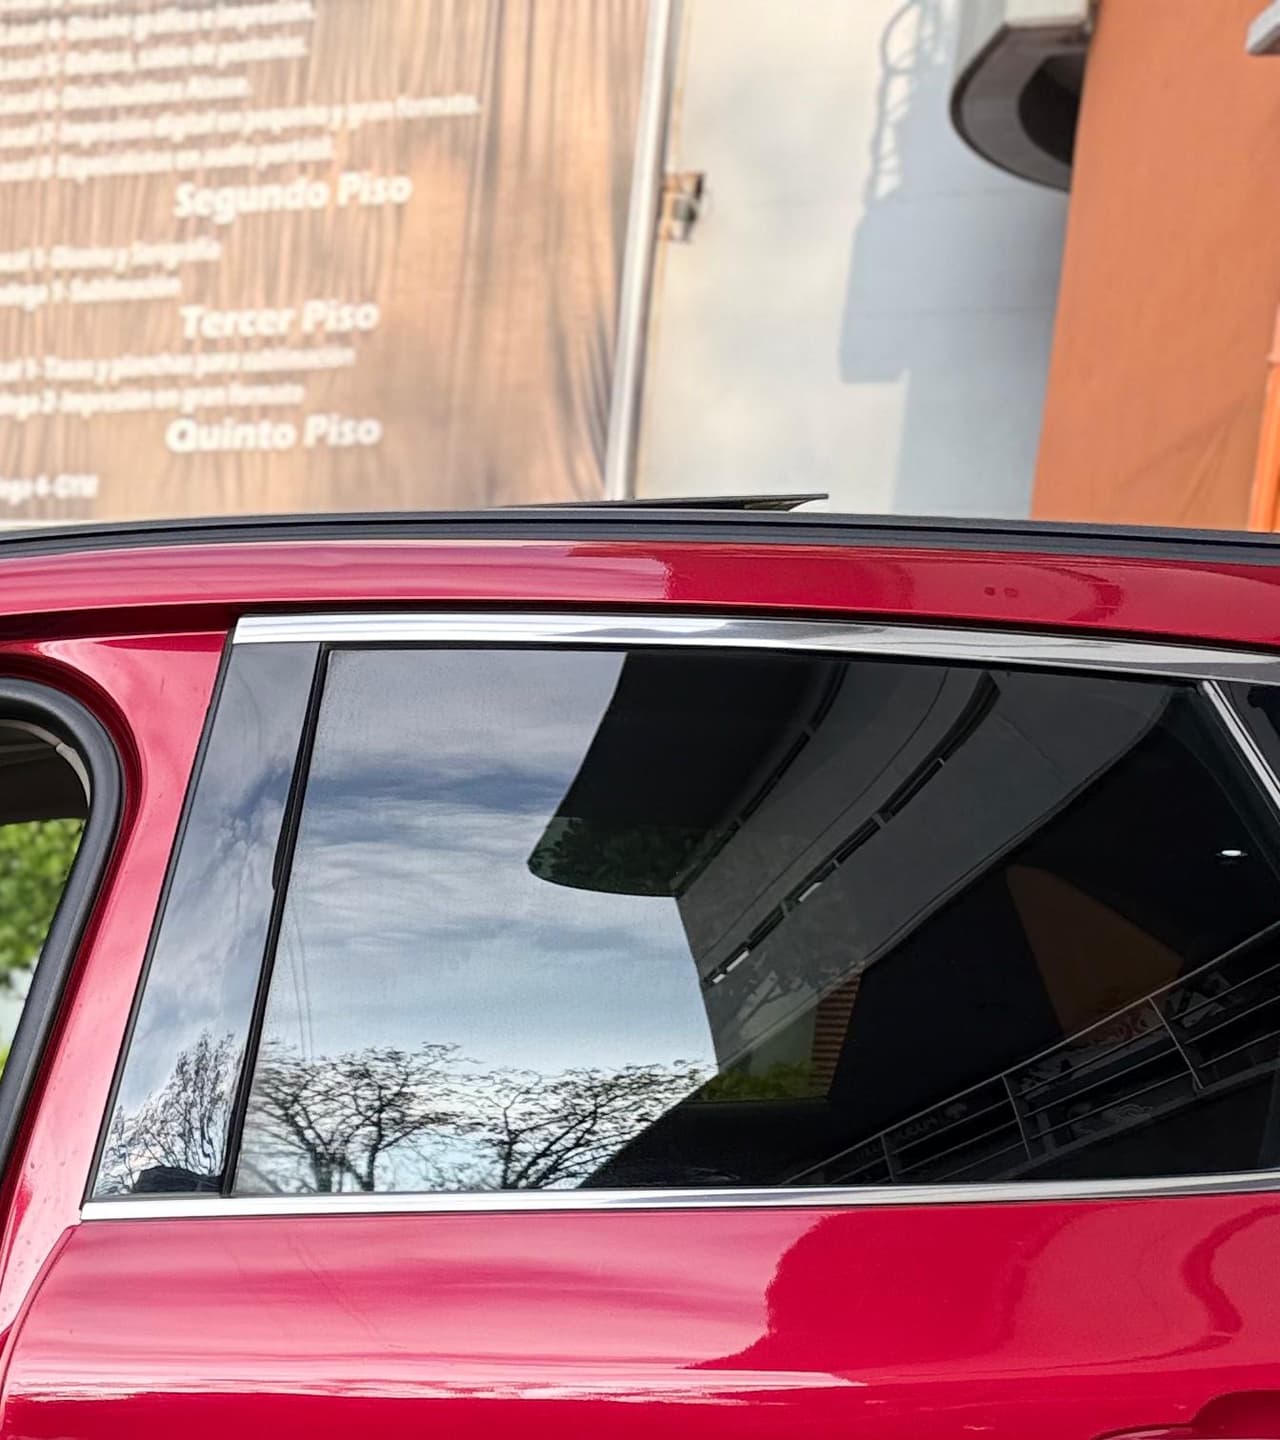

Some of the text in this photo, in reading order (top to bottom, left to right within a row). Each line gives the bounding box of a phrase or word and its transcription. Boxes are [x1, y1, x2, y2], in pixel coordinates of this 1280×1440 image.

[174, 171, 413, 224] Segundo Piso
[180, 298, 380, 340] Tercer Piso
[165, 413, 382, 453] Quinto Piso
